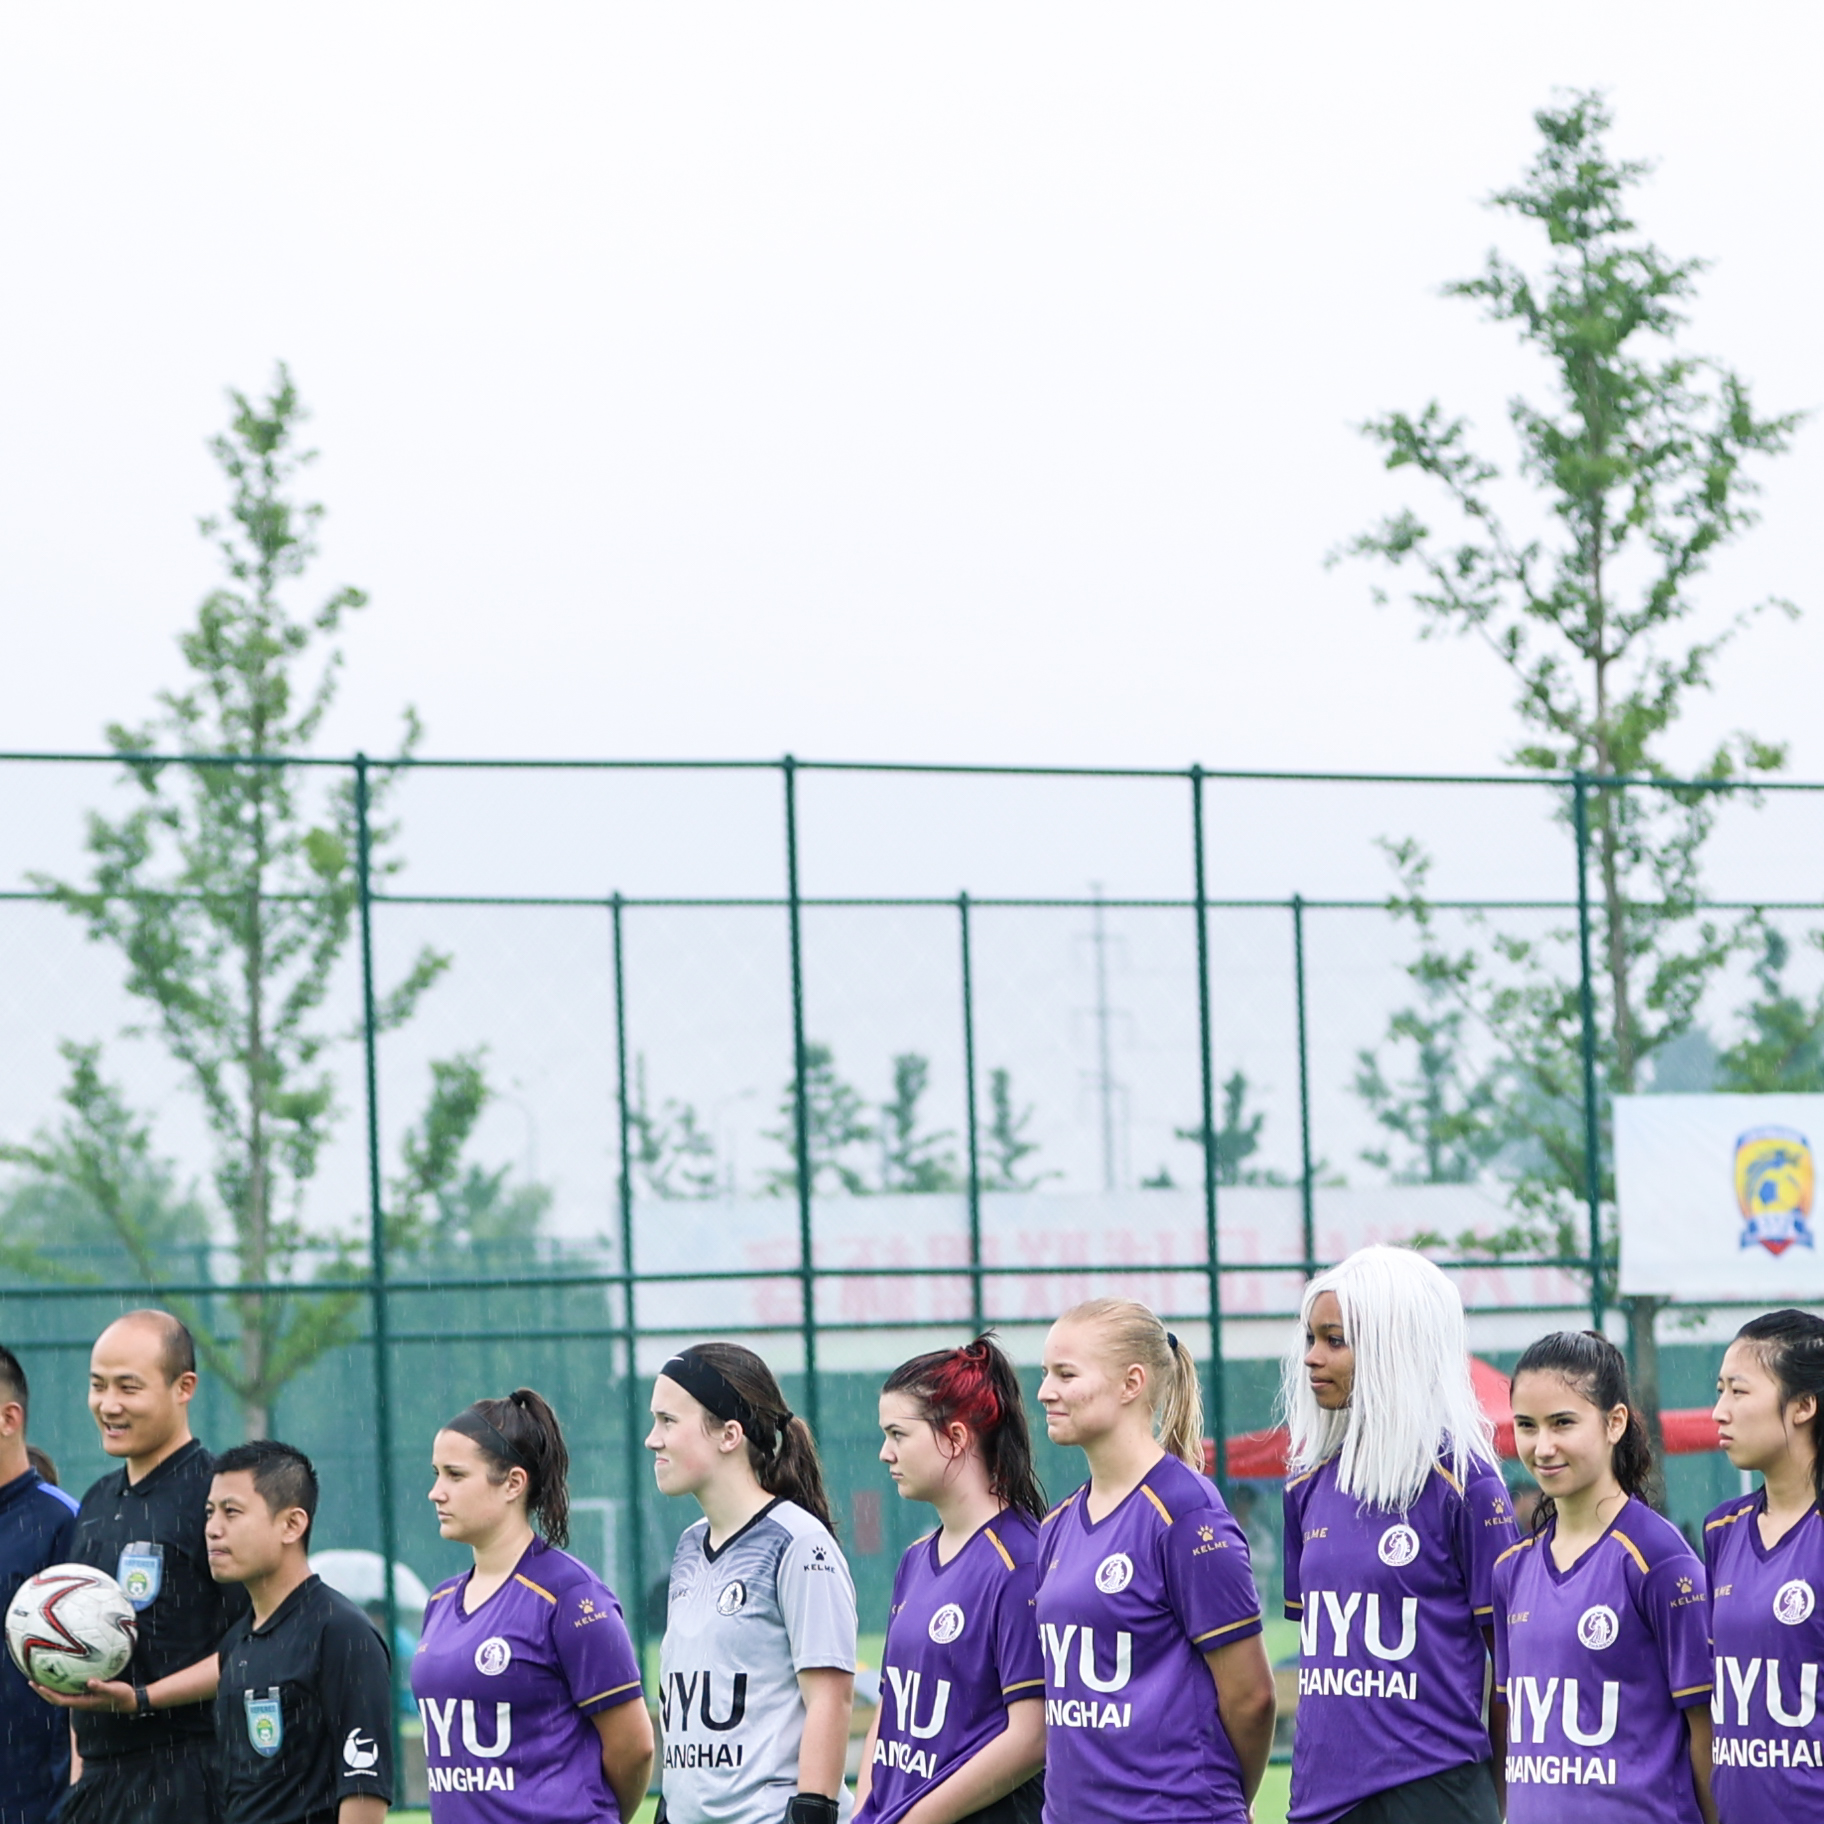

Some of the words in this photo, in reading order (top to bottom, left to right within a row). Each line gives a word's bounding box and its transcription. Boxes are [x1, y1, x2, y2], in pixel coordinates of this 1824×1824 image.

[1192, 1540, 1229, 1556] KELME
[803, 1564, 836, 1574] KELME
[1670, 1593, 1707, 1608] KELME
[574, 1610, 608, 1629] KELME
[1300, 1590, 1418, 1661] NYU
[663, 1743, 743, 1769] ANGHAI
